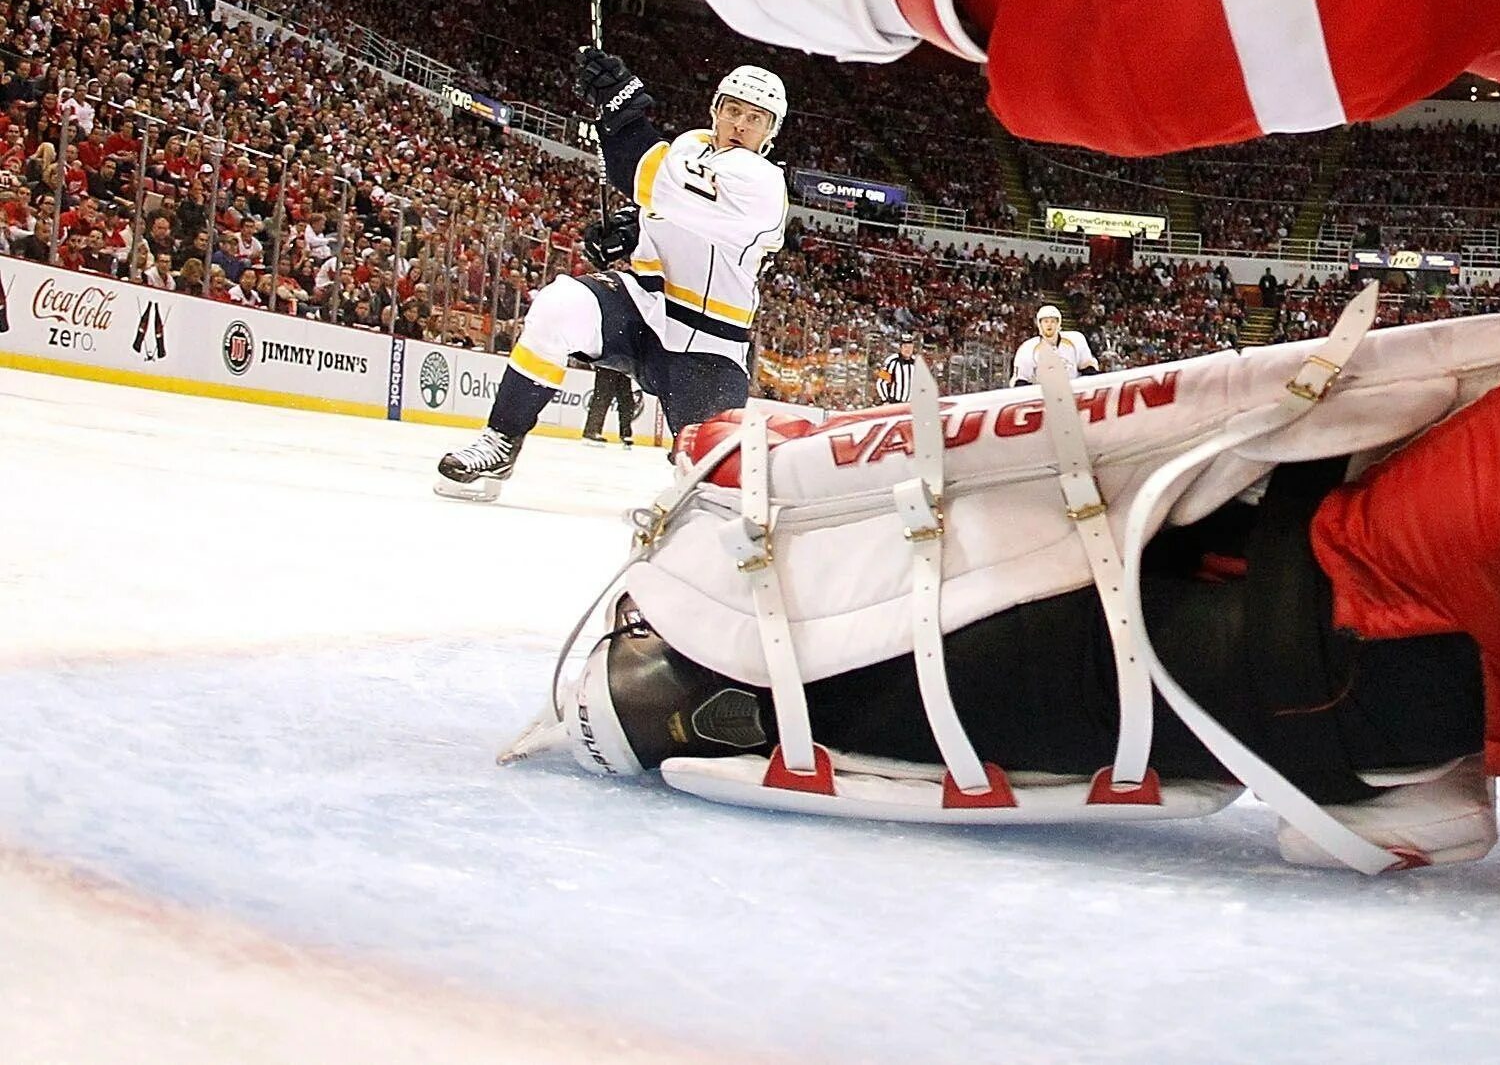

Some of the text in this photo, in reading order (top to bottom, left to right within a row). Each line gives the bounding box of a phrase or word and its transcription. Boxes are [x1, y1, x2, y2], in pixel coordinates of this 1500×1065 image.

[31, 277, 118, 330] Coca-Cola
[260, 340, 369, 374] JIMMY JOHN'S
[390, 339, 402, 407] Reebok
